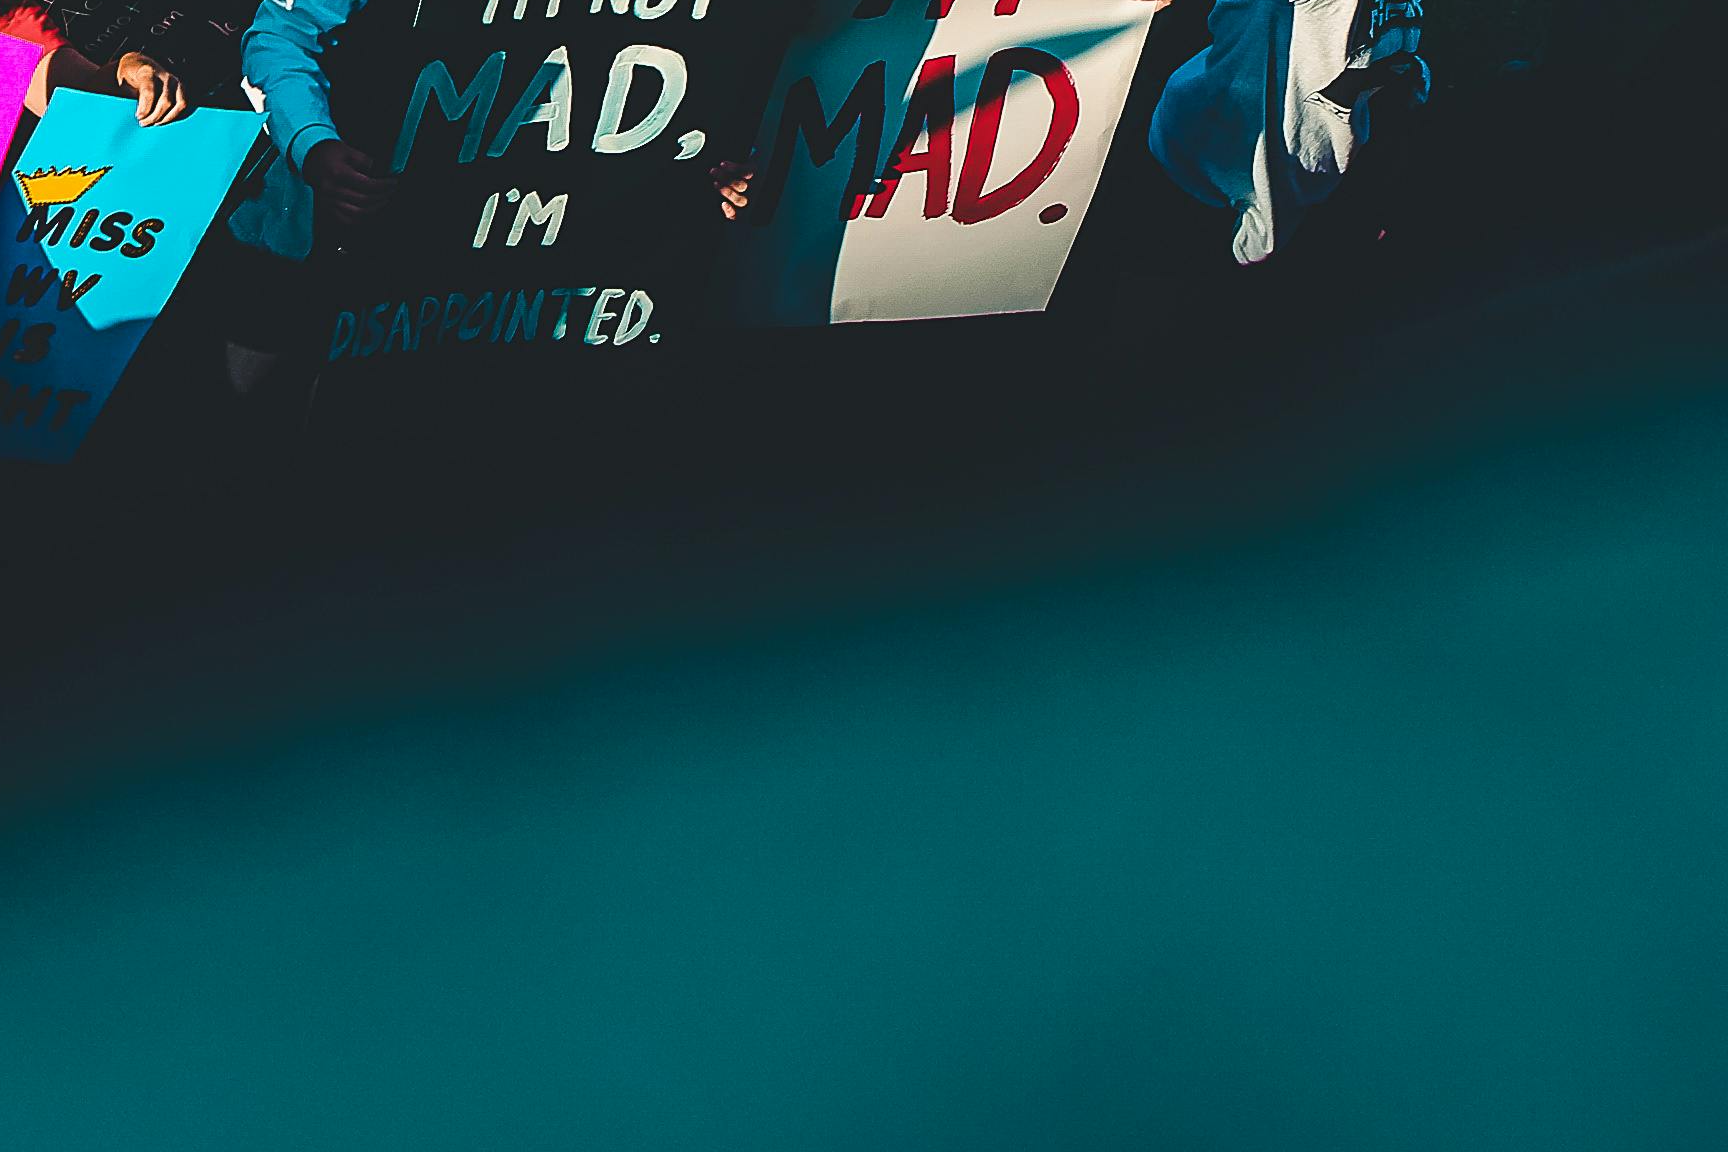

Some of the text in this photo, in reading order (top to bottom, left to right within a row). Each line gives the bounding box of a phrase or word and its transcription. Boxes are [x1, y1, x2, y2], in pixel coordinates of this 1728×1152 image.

[389, 44, 707, 175] MAD,
[747, 46, 1080, 227] MAD.
[15, 204, 166, 260] MISS
[472, 187, 570, 249] I'M
[327, 286, 663, 364] DISAPPOINTED.
